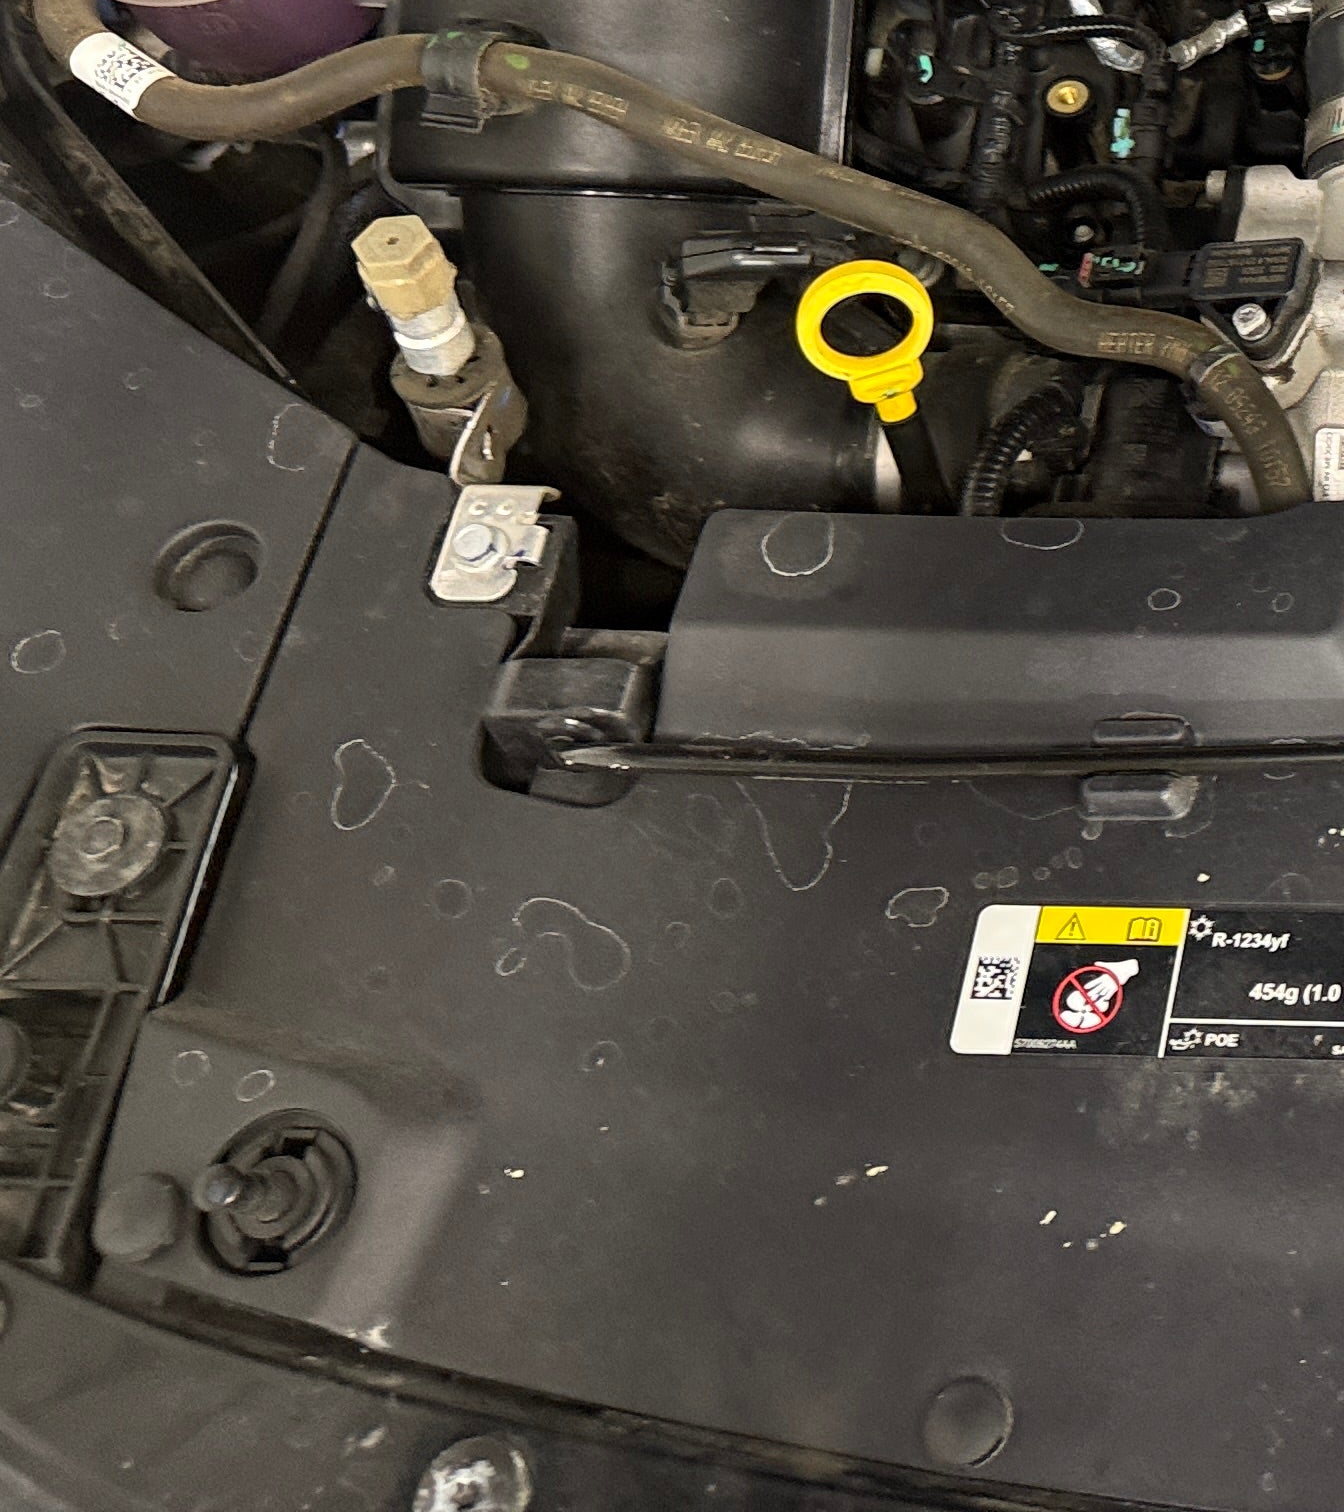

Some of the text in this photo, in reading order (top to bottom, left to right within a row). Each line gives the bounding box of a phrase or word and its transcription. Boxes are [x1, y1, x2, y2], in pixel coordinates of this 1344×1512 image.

[1212, 931, 1291, 951] R-1234yf
[1248, 983, 1297, 1006] 454g
[1304, 984, 1340, 1005] (1.0
[1204, 1032, 1240, 1048] POE
